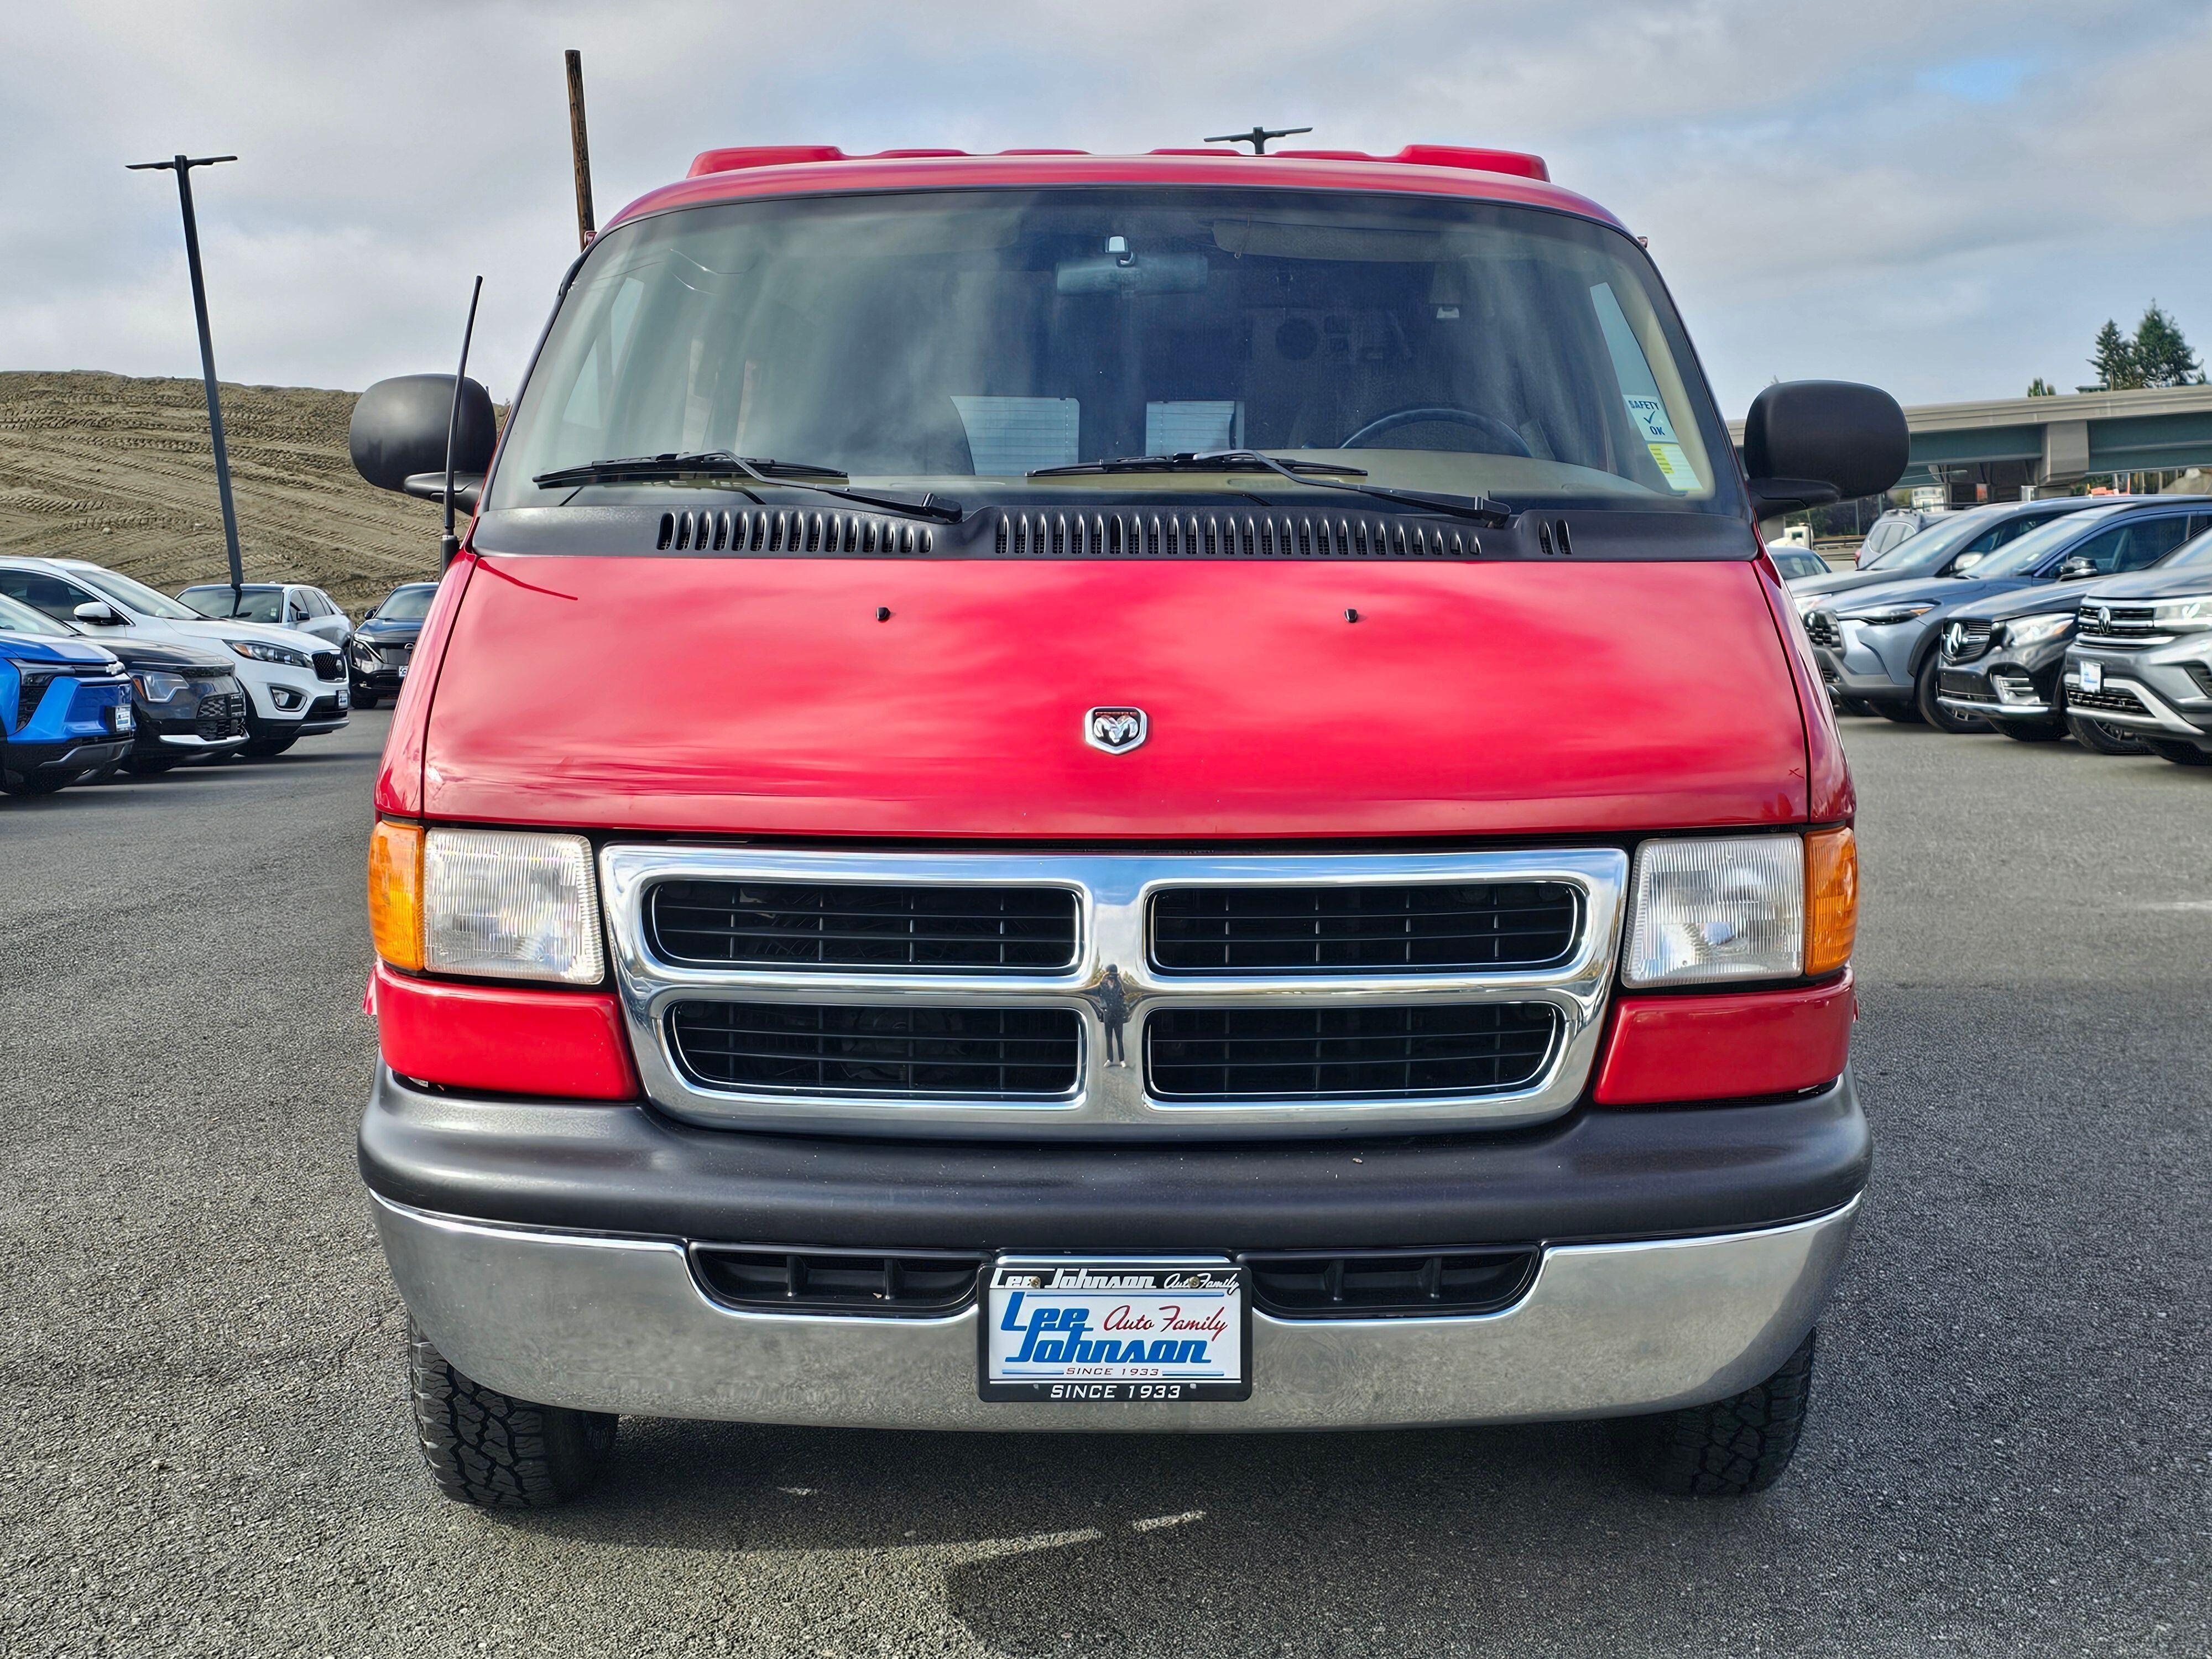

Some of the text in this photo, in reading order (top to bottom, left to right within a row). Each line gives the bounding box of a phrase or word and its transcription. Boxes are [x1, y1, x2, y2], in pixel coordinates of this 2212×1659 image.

[1628, 400, 1659, 410] SAFETY
[1650, 426, 1665, 436] OK
[1045, 1269, 1156, 1288] Johnson
[1164, 1273, 1198, 1288] Aut
[1198, 1272, 1239, 1294] Family
[1000, 1291, 1228, 1342] Lee Auto Family
[1005, 1327, 1212, 1363] Johnson
[1066, 1367, 1113, 1375] SINCE
[1050, 1385, 1181, 1398] SINCE 1933
